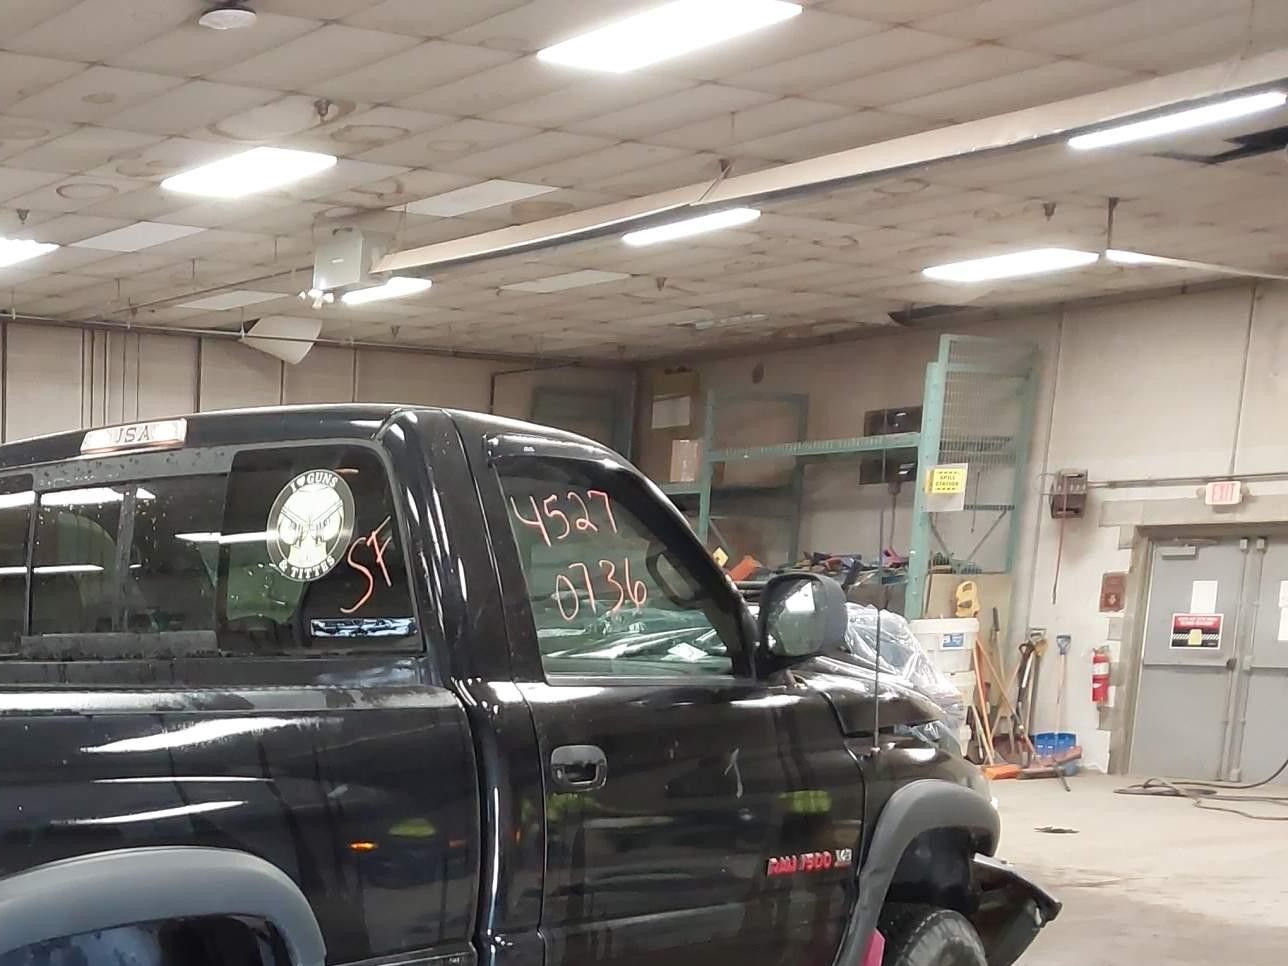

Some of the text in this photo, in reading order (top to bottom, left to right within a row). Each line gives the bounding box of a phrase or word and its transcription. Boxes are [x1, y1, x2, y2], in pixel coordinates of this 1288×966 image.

[306, 471, 339, 488] GUNS
[510, 489, 618, 548] 4527
[554, 557, 648, 622] 0736
[768, 855, 797, 875] RAM
[799, 850, 832, 871] 1500
